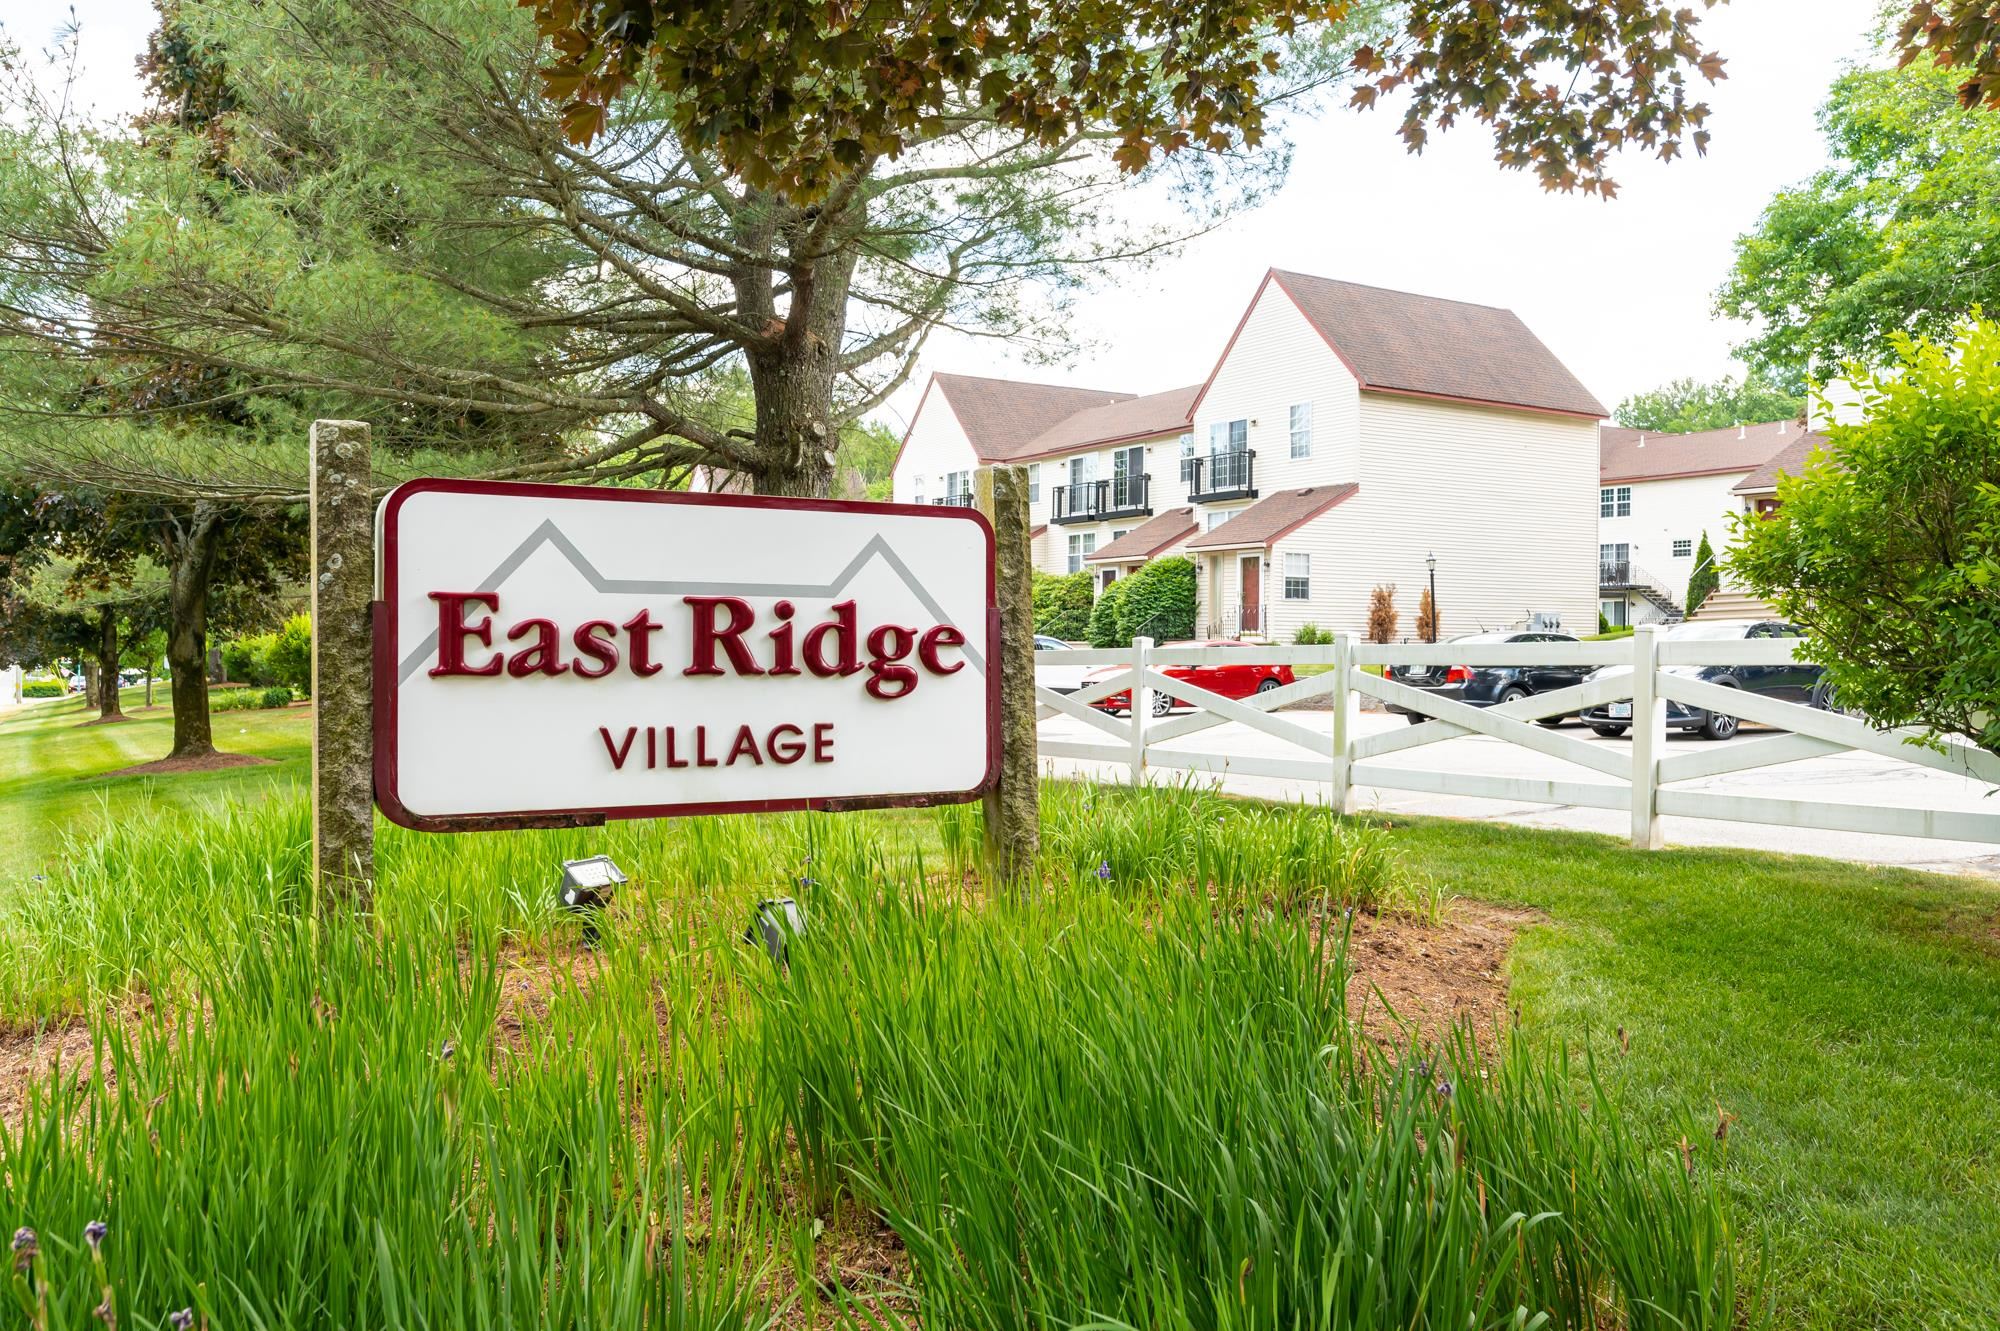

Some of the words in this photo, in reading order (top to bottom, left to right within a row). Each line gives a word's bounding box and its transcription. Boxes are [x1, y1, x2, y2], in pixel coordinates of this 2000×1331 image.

[428, 591, 664, 678] East
[682, 595, 966, 700] Ridge
[600, 722, 835, 769] VILLAGE
